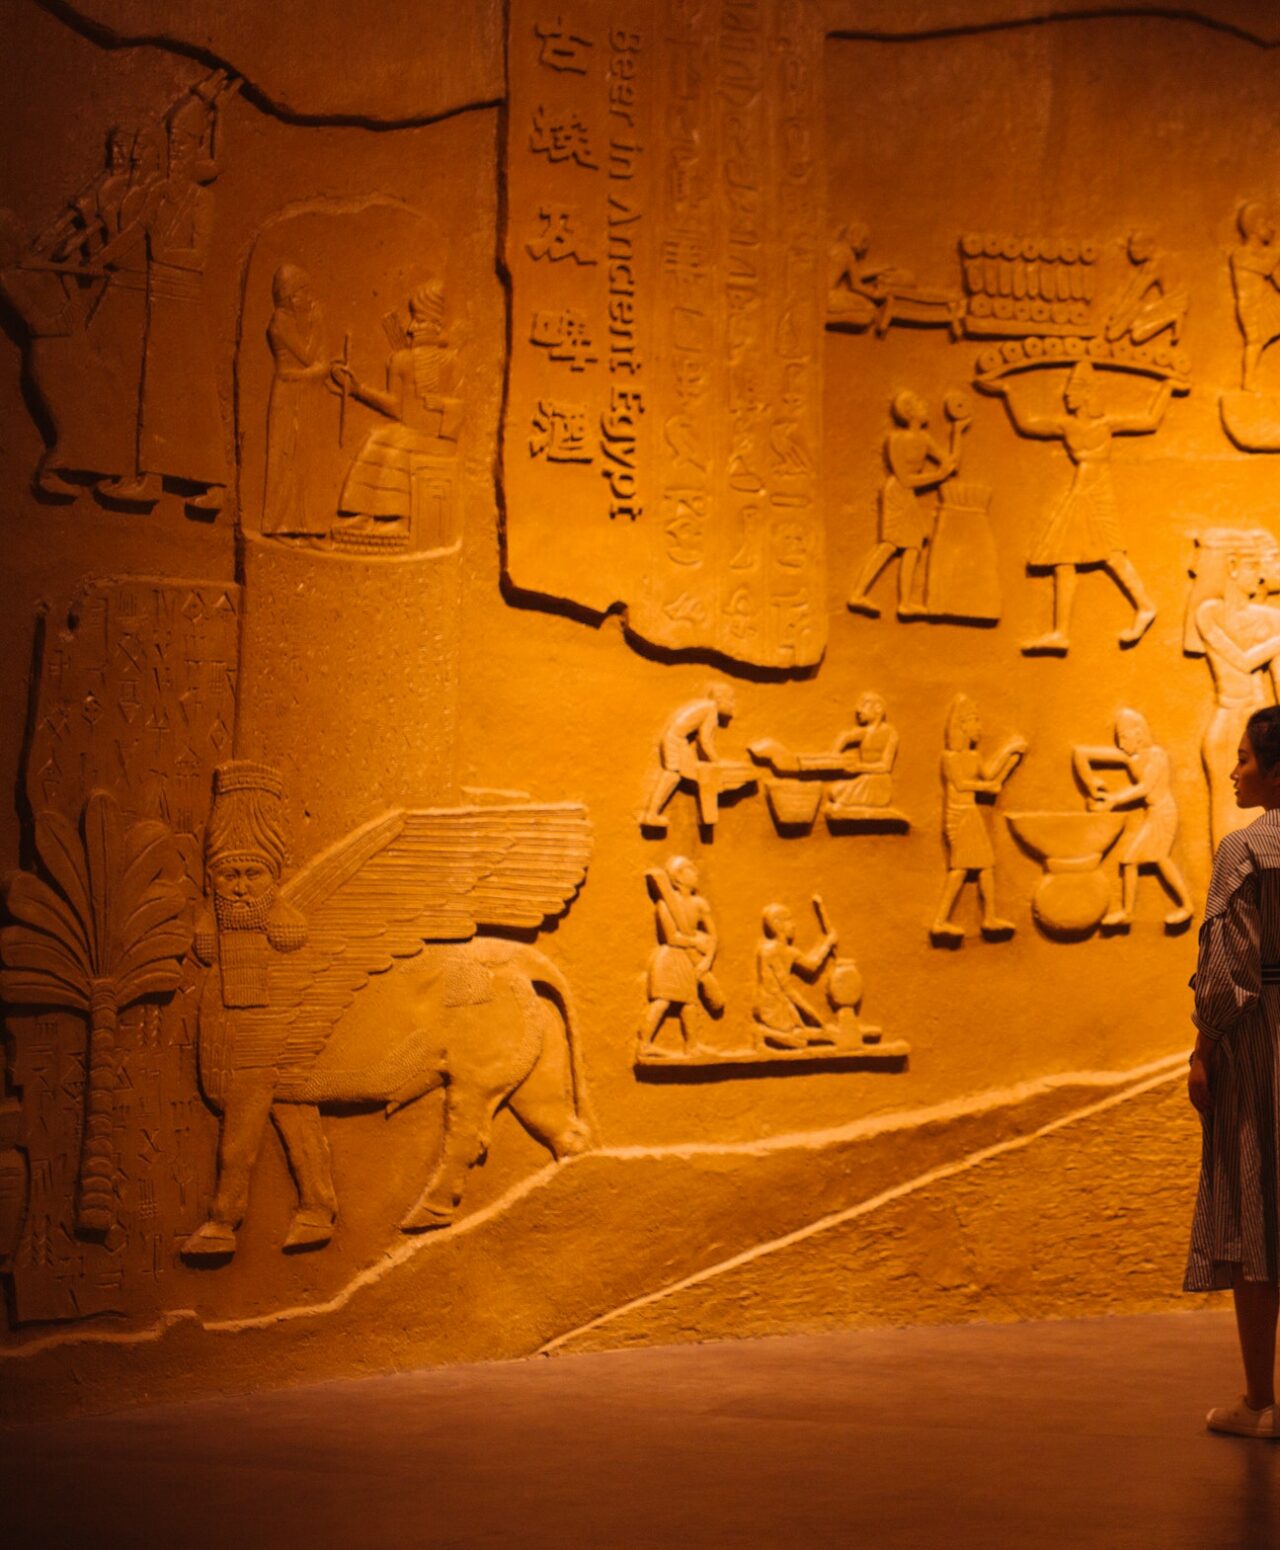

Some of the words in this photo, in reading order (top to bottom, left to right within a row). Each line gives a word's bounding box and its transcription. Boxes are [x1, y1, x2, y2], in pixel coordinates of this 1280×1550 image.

[608, 25, 642, 128] Beer
[608, 141, 644, 181] in
[525, 15, 600, 466] 古埃及啤酒
[607, 194, 643, 376] Ancient
[600, 387, 646, 522] Egypt
